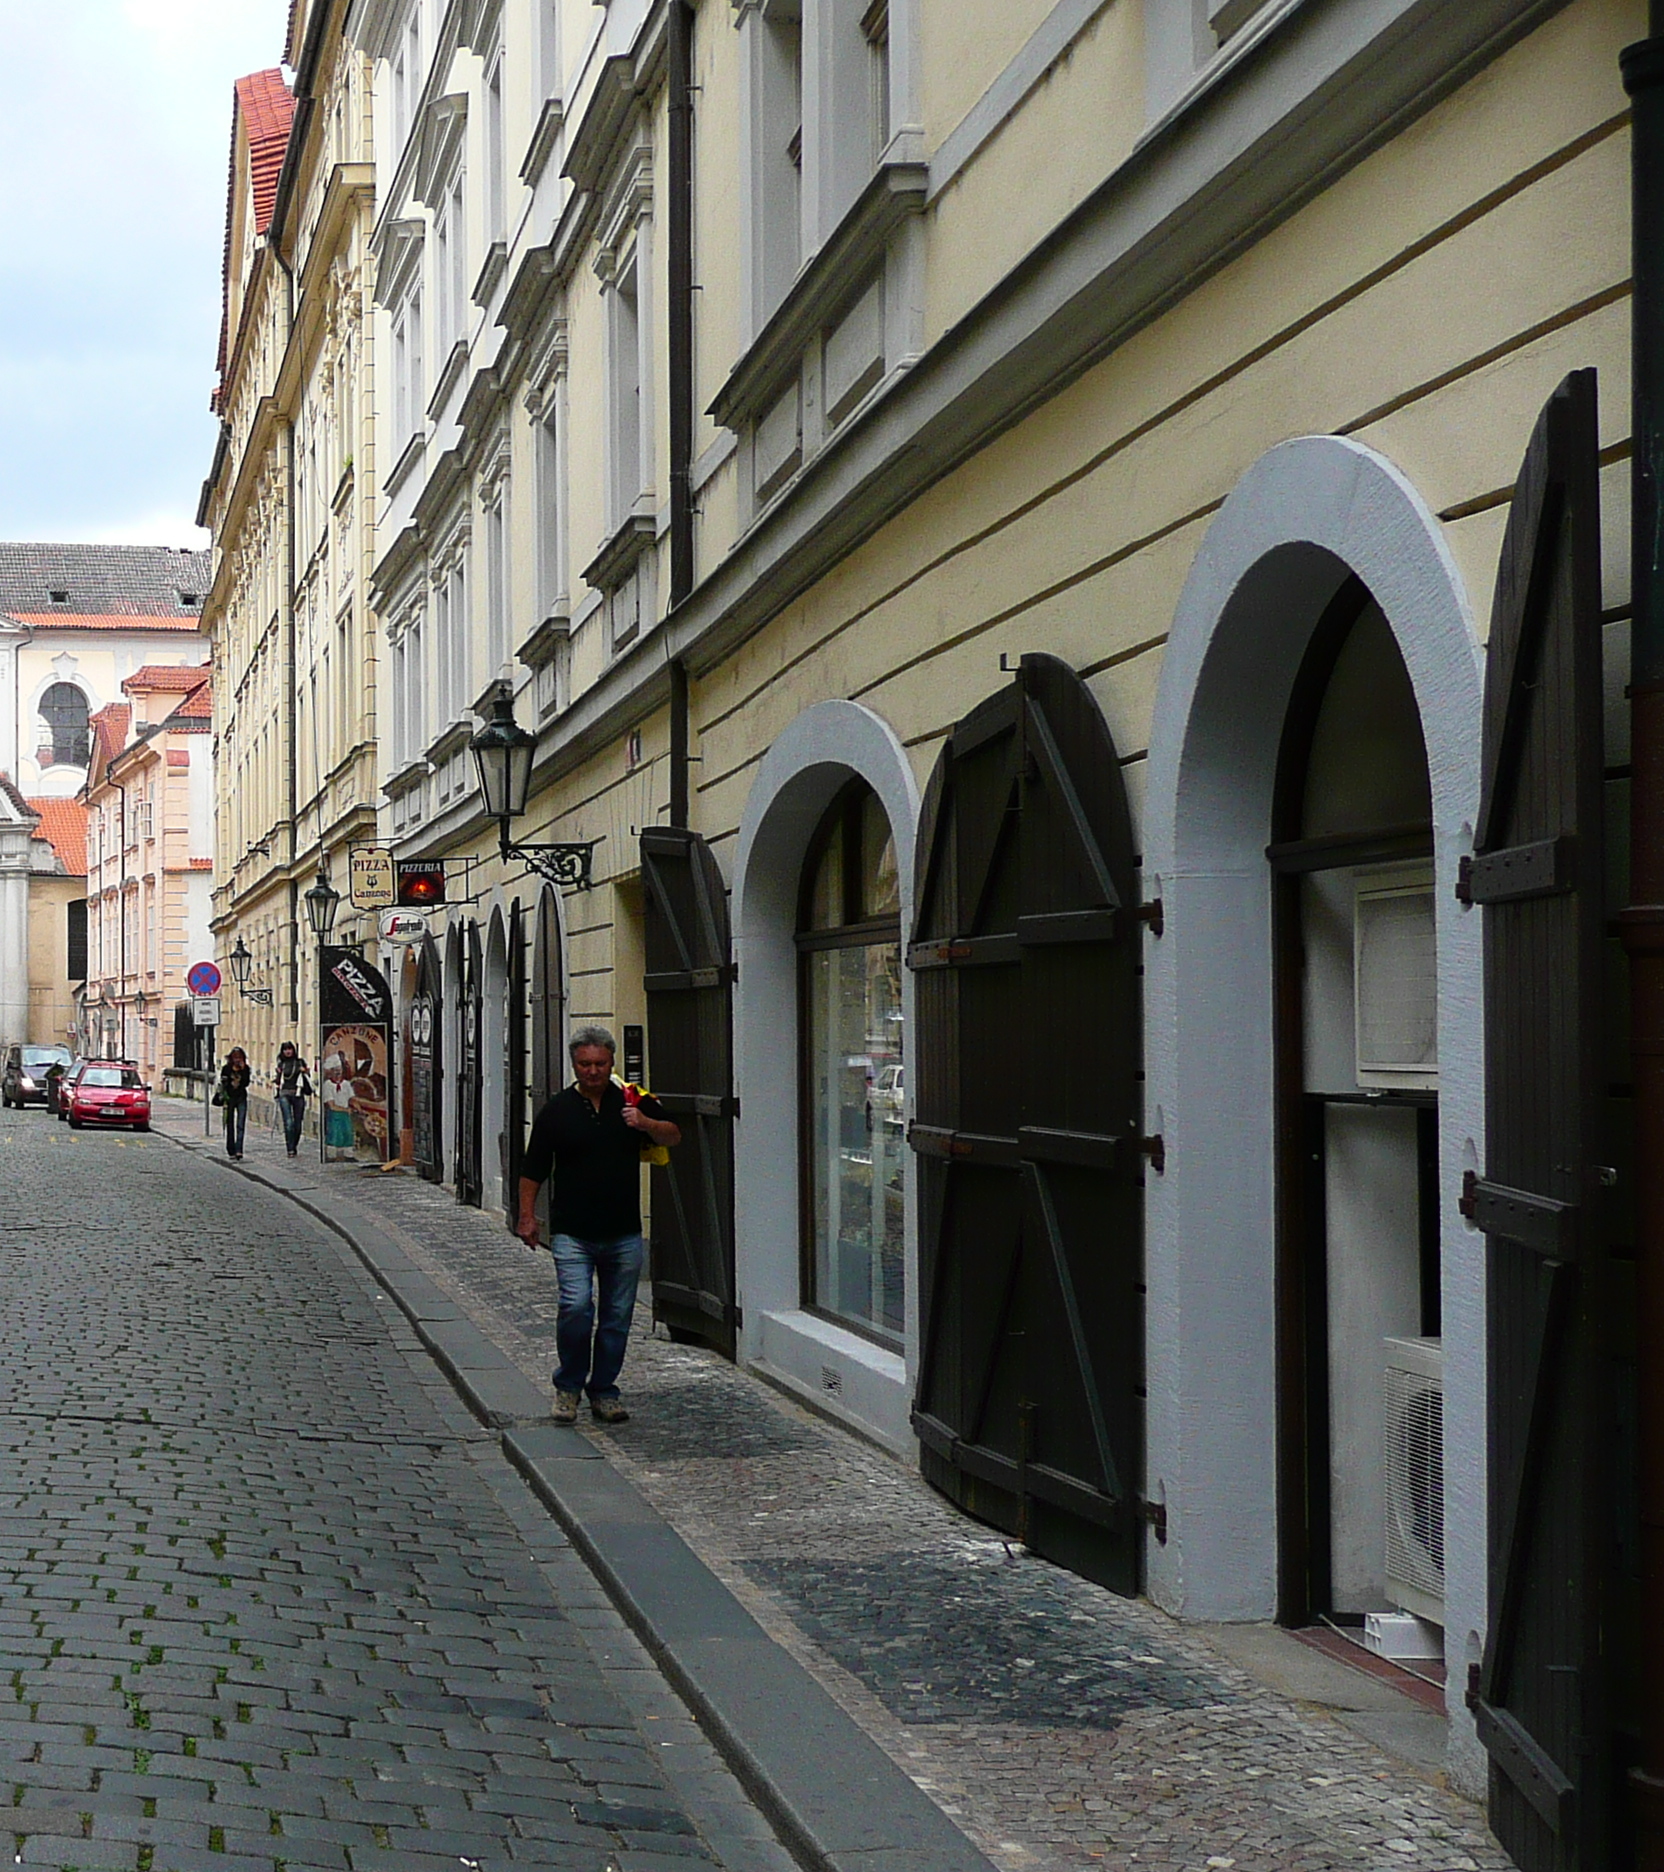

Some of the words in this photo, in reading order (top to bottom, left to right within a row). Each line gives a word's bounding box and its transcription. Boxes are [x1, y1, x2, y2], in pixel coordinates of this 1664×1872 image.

[353, 859, 390, 872] PIZZA
[399, 862, 441, 873] PIZZERIA
[354, 888, 391, 898] Canzone
[337, 959, 383, 1015] PIZZA
[329, 1026, 378, 1046] CANZONE
